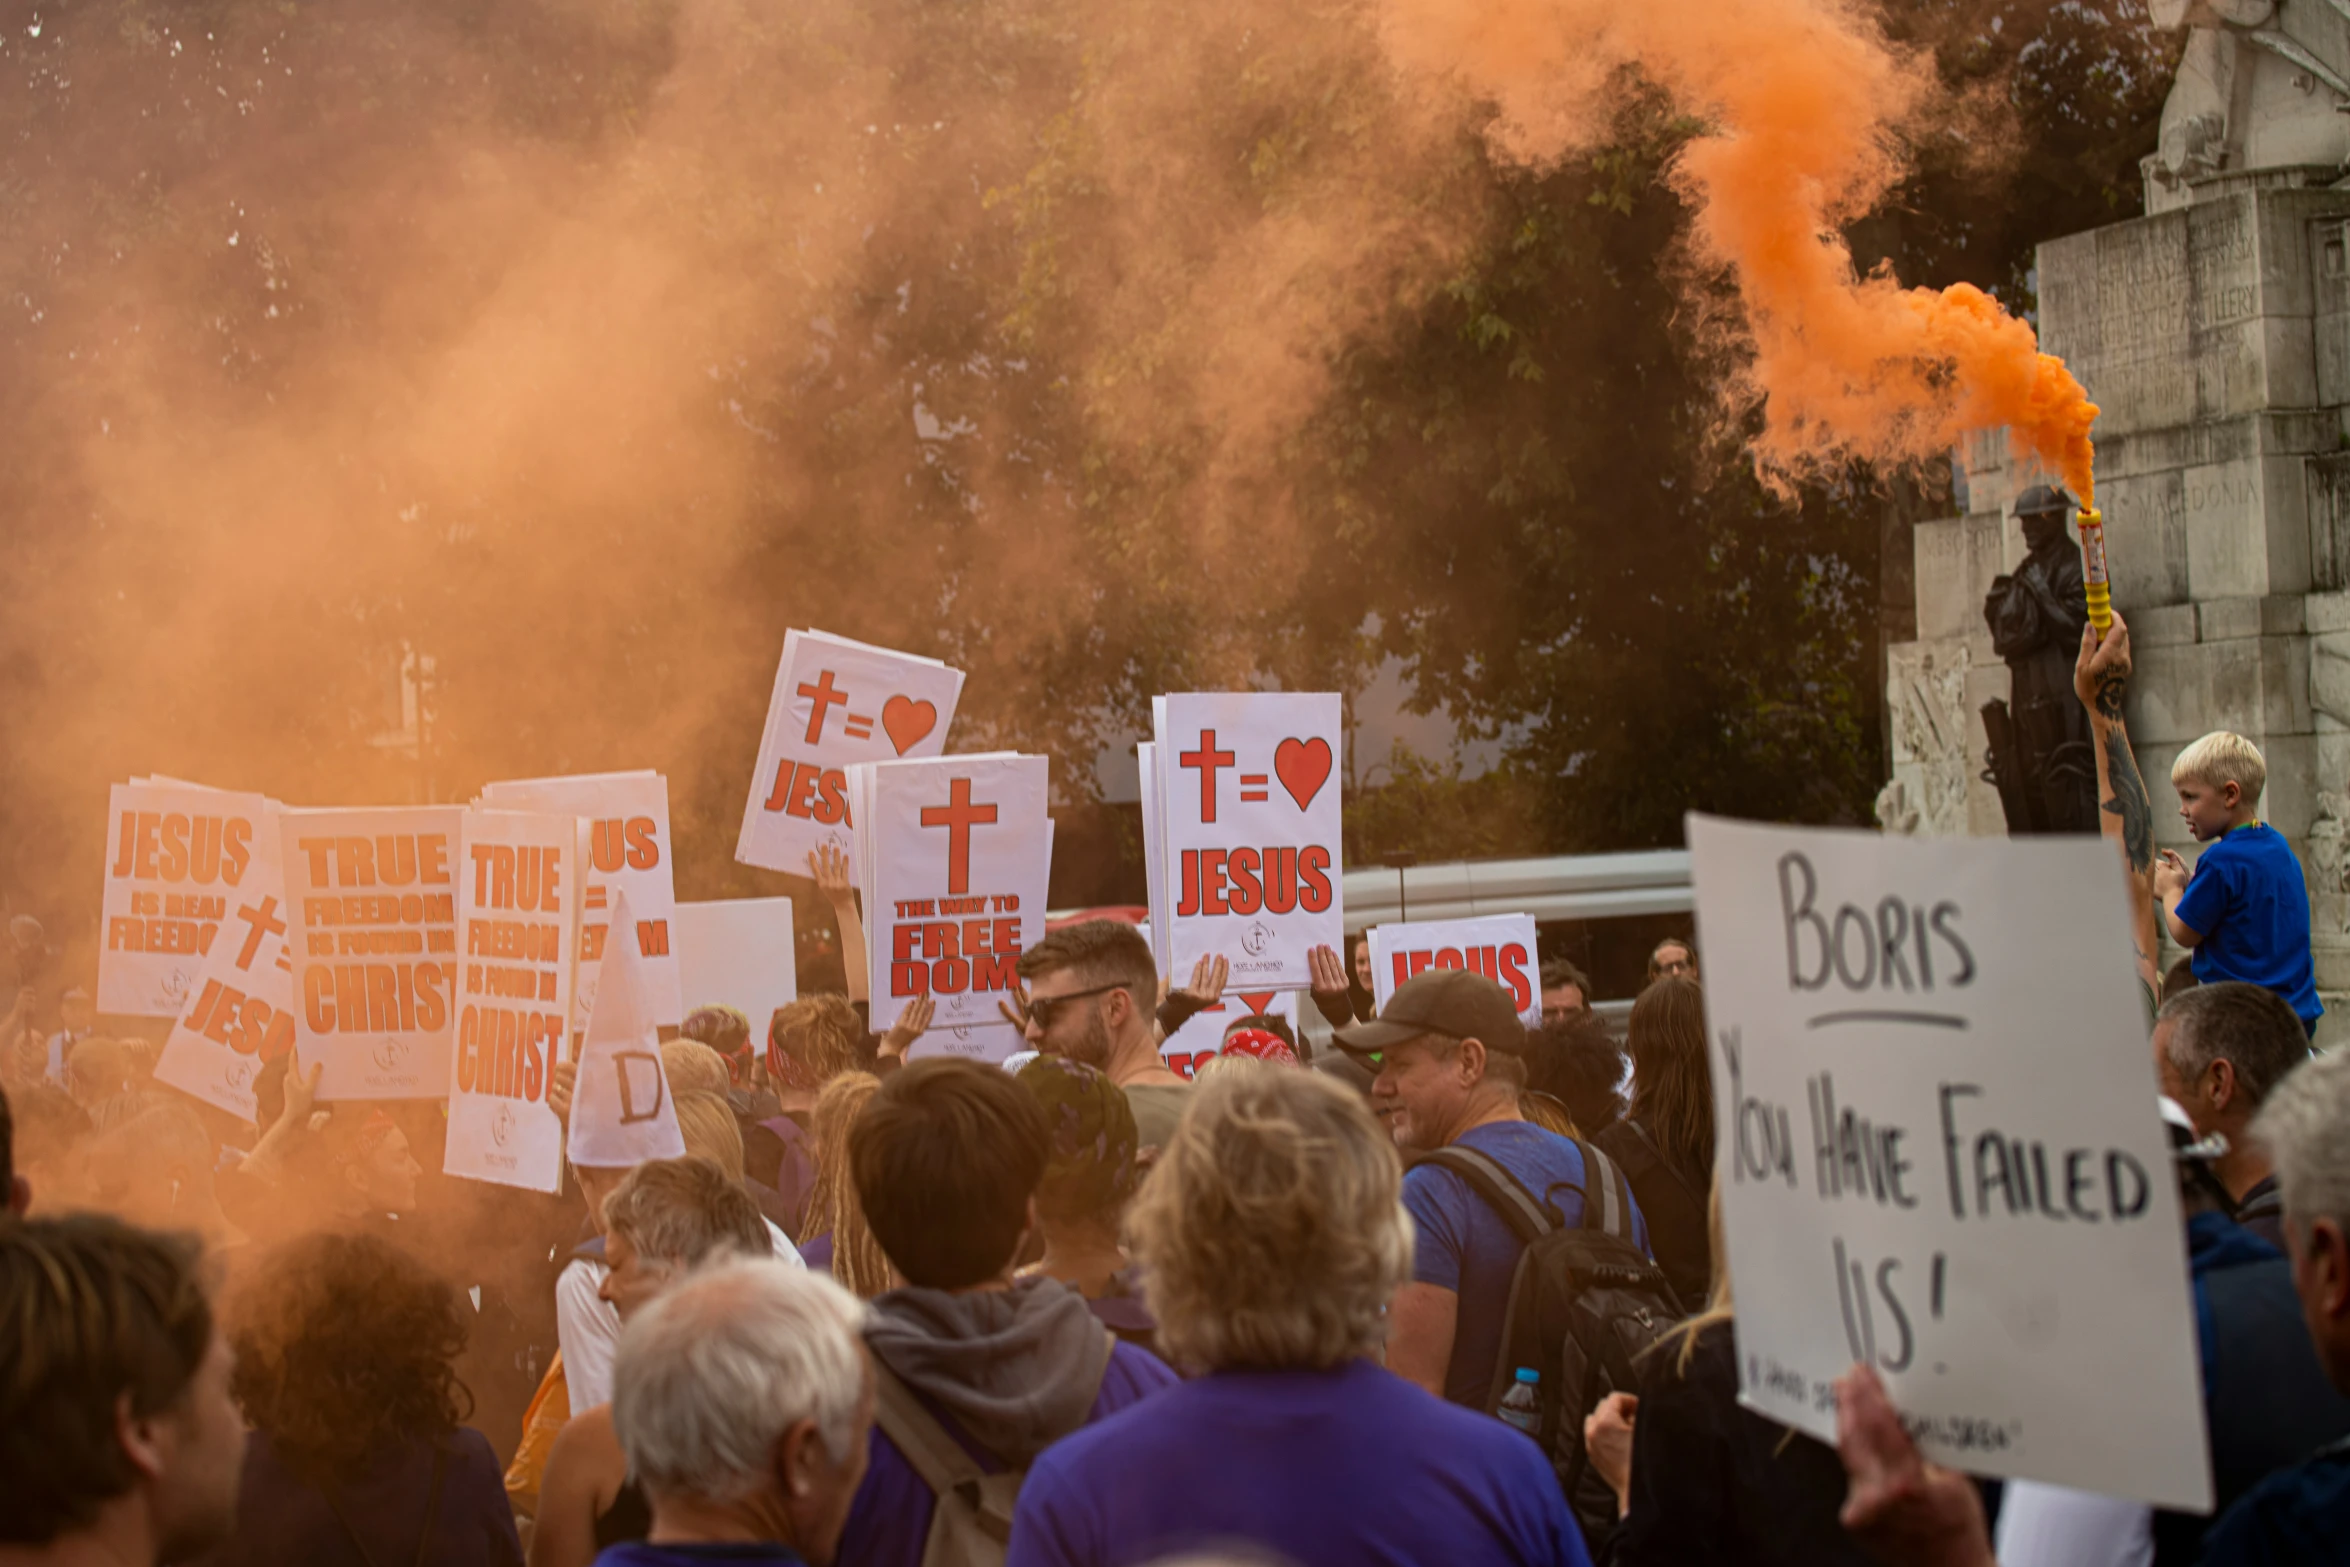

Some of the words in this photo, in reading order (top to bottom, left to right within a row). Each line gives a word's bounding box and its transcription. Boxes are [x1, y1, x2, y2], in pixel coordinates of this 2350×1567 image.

[764, 757, 853, 832] JES
[113, 810, 253, 888] JESUS
[299, 833, 450, 888] TRUE
[131, 889, 160, 916] IS
[164, 893, 226, 921] REAL
[470, 842, 561, 913] TRUE
[1177, 845, 1333, 917] JESUS
[303, 891, 454, 927] FREEDOM
[893, 898, 935, 919] THE
[938, 895, 988, 917] WAY
[989, 893, 1020, 914] TO
[1777, 850, 1977, 994] BORIS
[108, 916, 219, 958] FREEDO
[307, 931, 334, 957] IS
[338, 930, 423, 956] FOUND
[426, 928, 456, 954] IN
[468, 917, 559, 964] FREEDOM
[892, 917, 1022, 962] FREE
[466, 962, 483, 994] IS
[485, 964, 536, 999] FOUND
[538, 969, 557, 1002] IN
[890, 955, 1022, 999] DOM
[183, 977, 297, 1065] JESU
[457, 1002, 563, 1104] CHRIST
[611, 1050, 663, 1126] D
[1806, 1068, 1920, 1212] HAVE
[1937, 1080, 2153, 1223] FAILED
